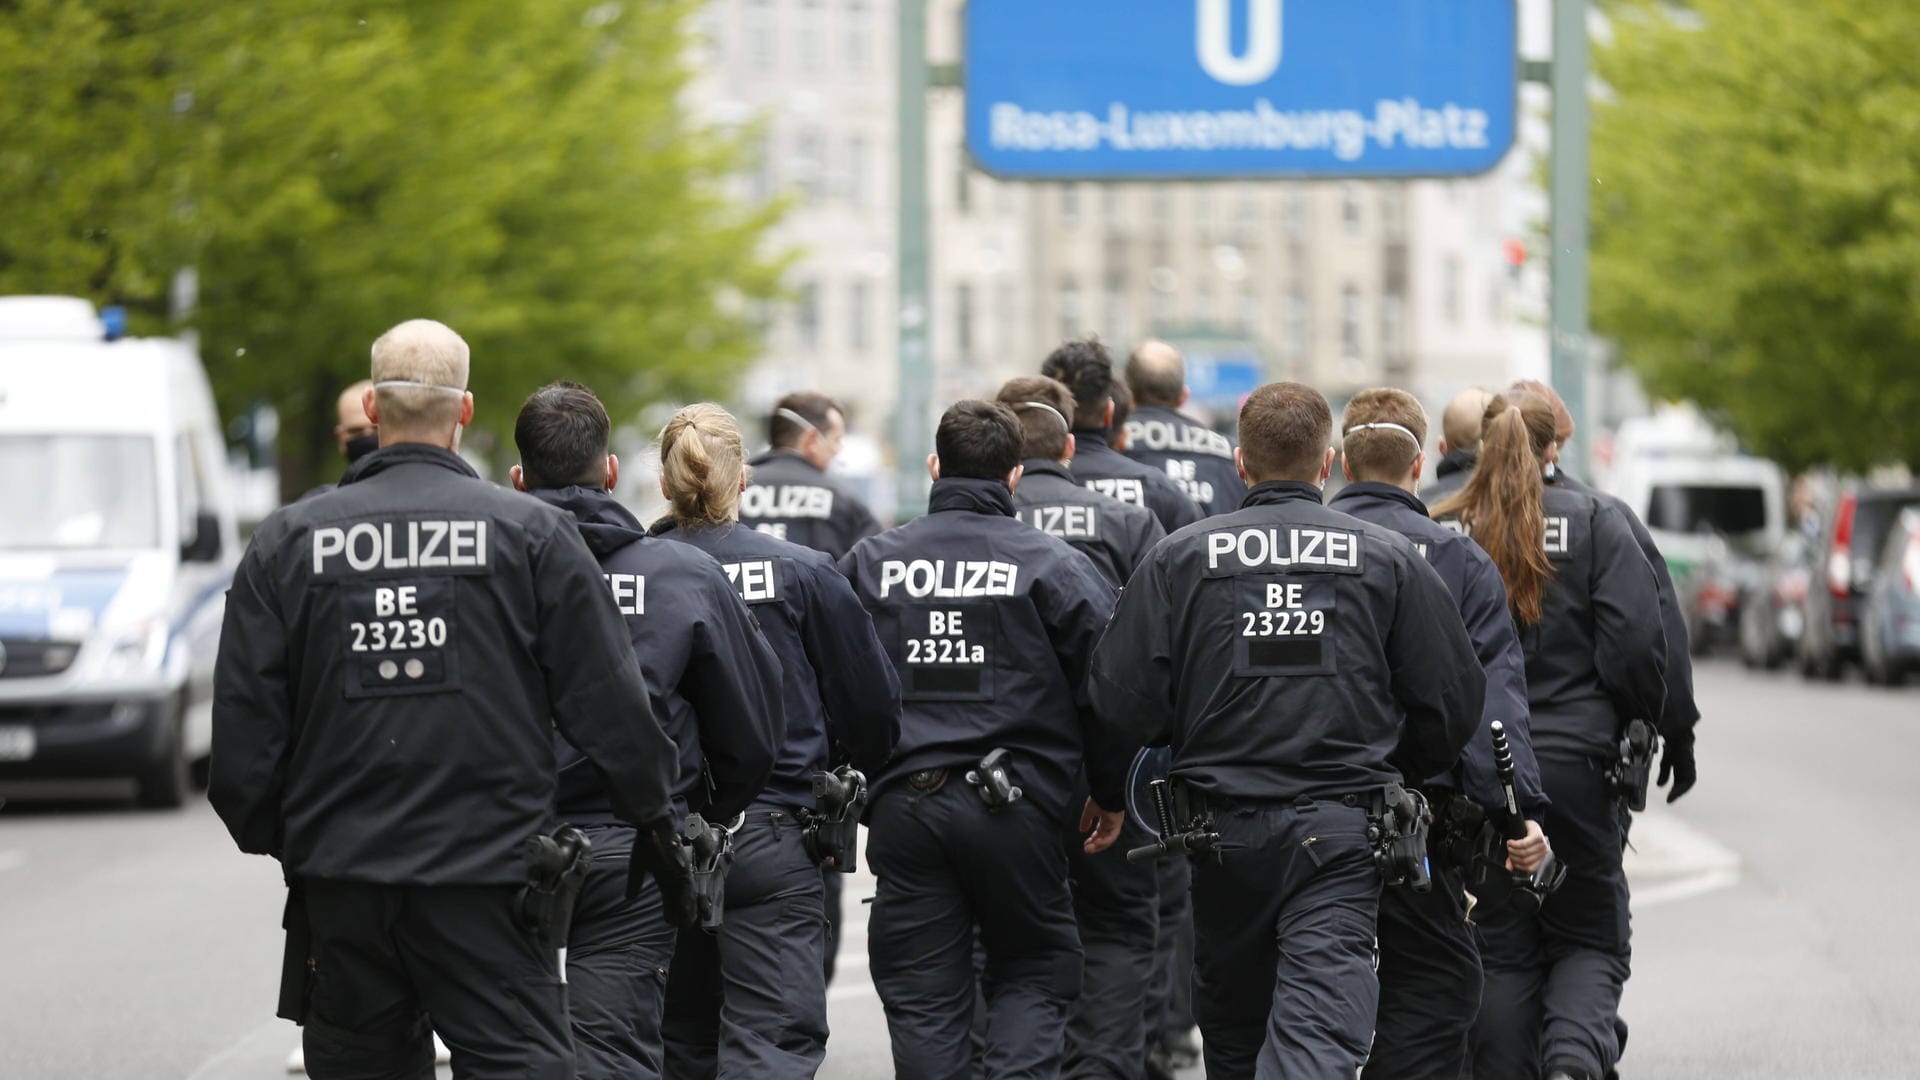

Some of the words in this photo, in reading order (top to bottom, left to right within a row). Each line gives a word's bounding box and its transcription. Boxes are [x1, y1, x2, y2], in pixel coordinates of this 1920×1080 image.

[1195, 0, 1283, 87] U
[989, 98, 1490, 162] Rosa-Luxemburg-Platz
[1122, 420, 1233, 459] POLIZEI
[1166, 458, 1196, 481] BE
[741, 485, 834, 519] OLIZEI
[1015, 506, 1095, 537] IZEI
[312, 520, 488, 575] POLIZEI
[1207, 528, 1359, 569] POLIZEI
[880, 559, 1018, 598] POLIZEI
[375, 586, 419, 617] BE
[1266, 583, 1303, 609] BE
[350, 617, 448, 652] 23230
[929, 611, 964, 635] BE
[1242, 610, 1326, 637] 23229
[906, 639, 986, 664] 2321a
